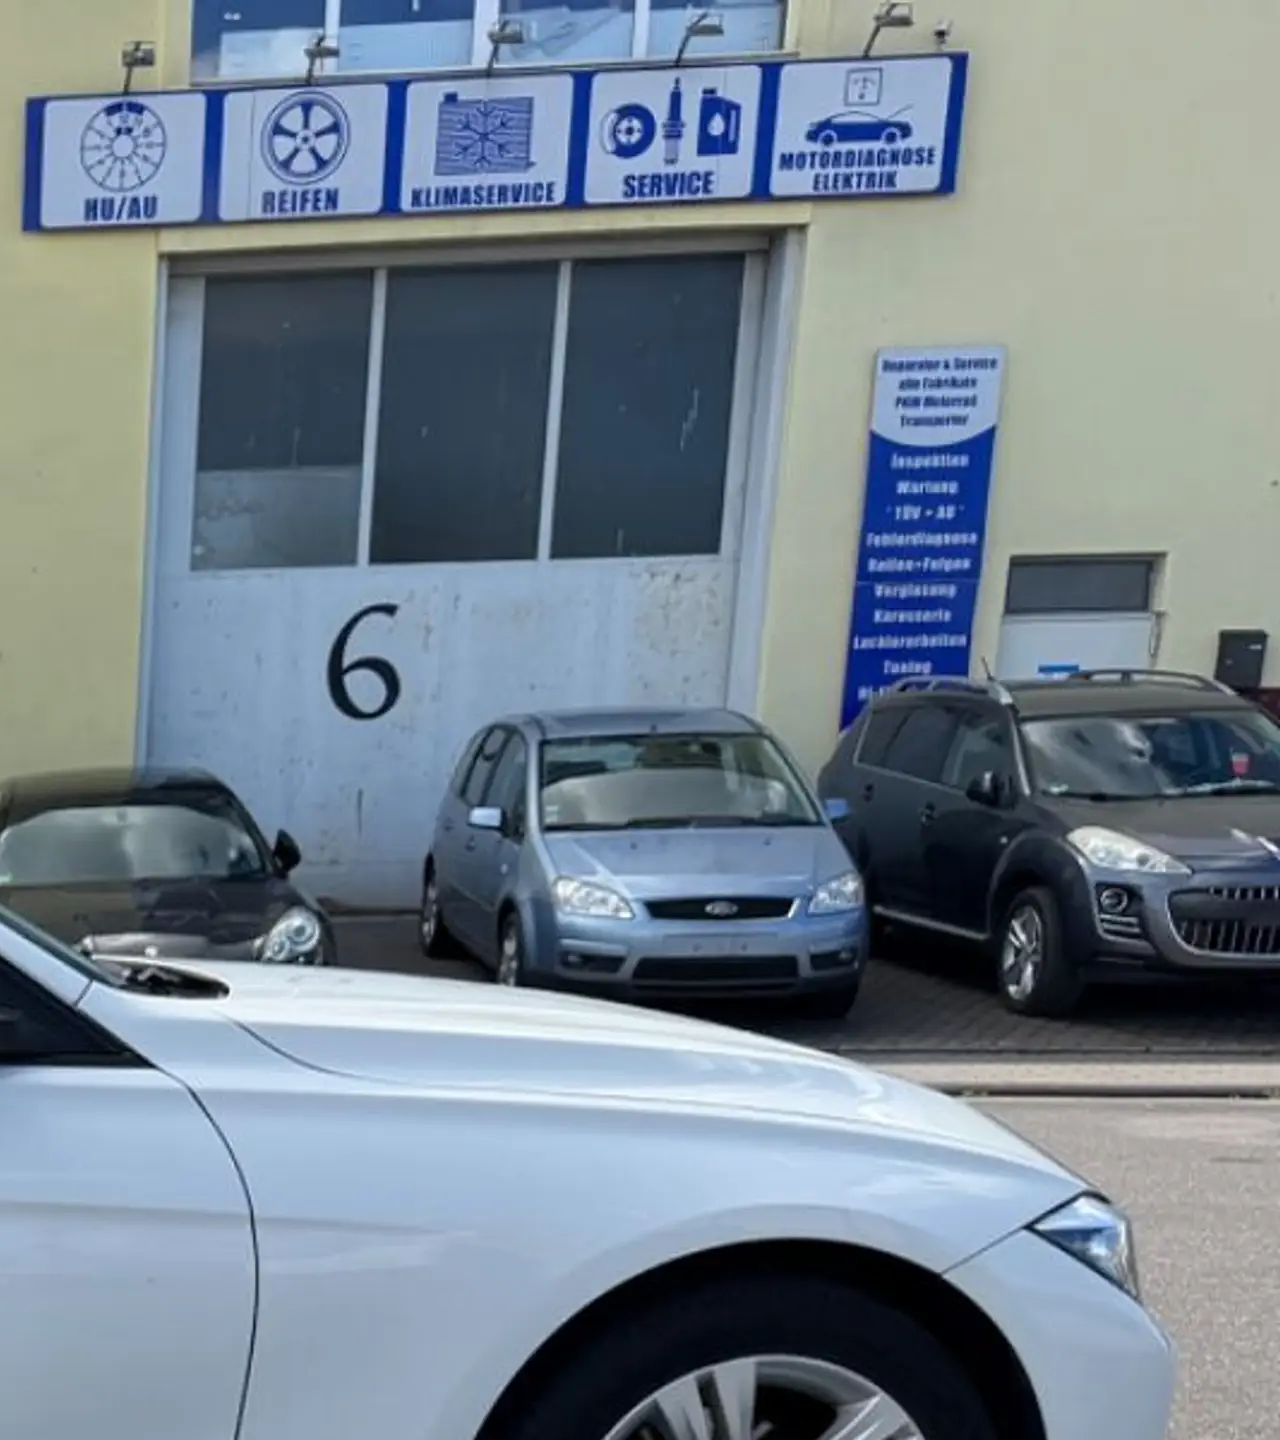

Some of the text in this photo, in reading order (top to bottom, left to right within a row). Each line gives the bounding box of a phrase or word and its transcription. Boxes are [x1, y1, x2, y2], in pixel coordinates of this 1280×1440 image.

[778, 146, 937, 171] MOTORDIAGNOSE
[622, 170, 716, 199] SERVICE
[812, 170, 899, 192] ELEKTRIK
[261, 187, 340, 214] REIFEN
[410, 181, 556, 209] KLIMASERVICE
[84, 195, 158, 222] HU/AU
[953, 356, 998, 371] Service
[890, 453, 970, 470] Inspektion
[896, 480, 959, 495] Wartung
[326, 602, 402, 721] 6
